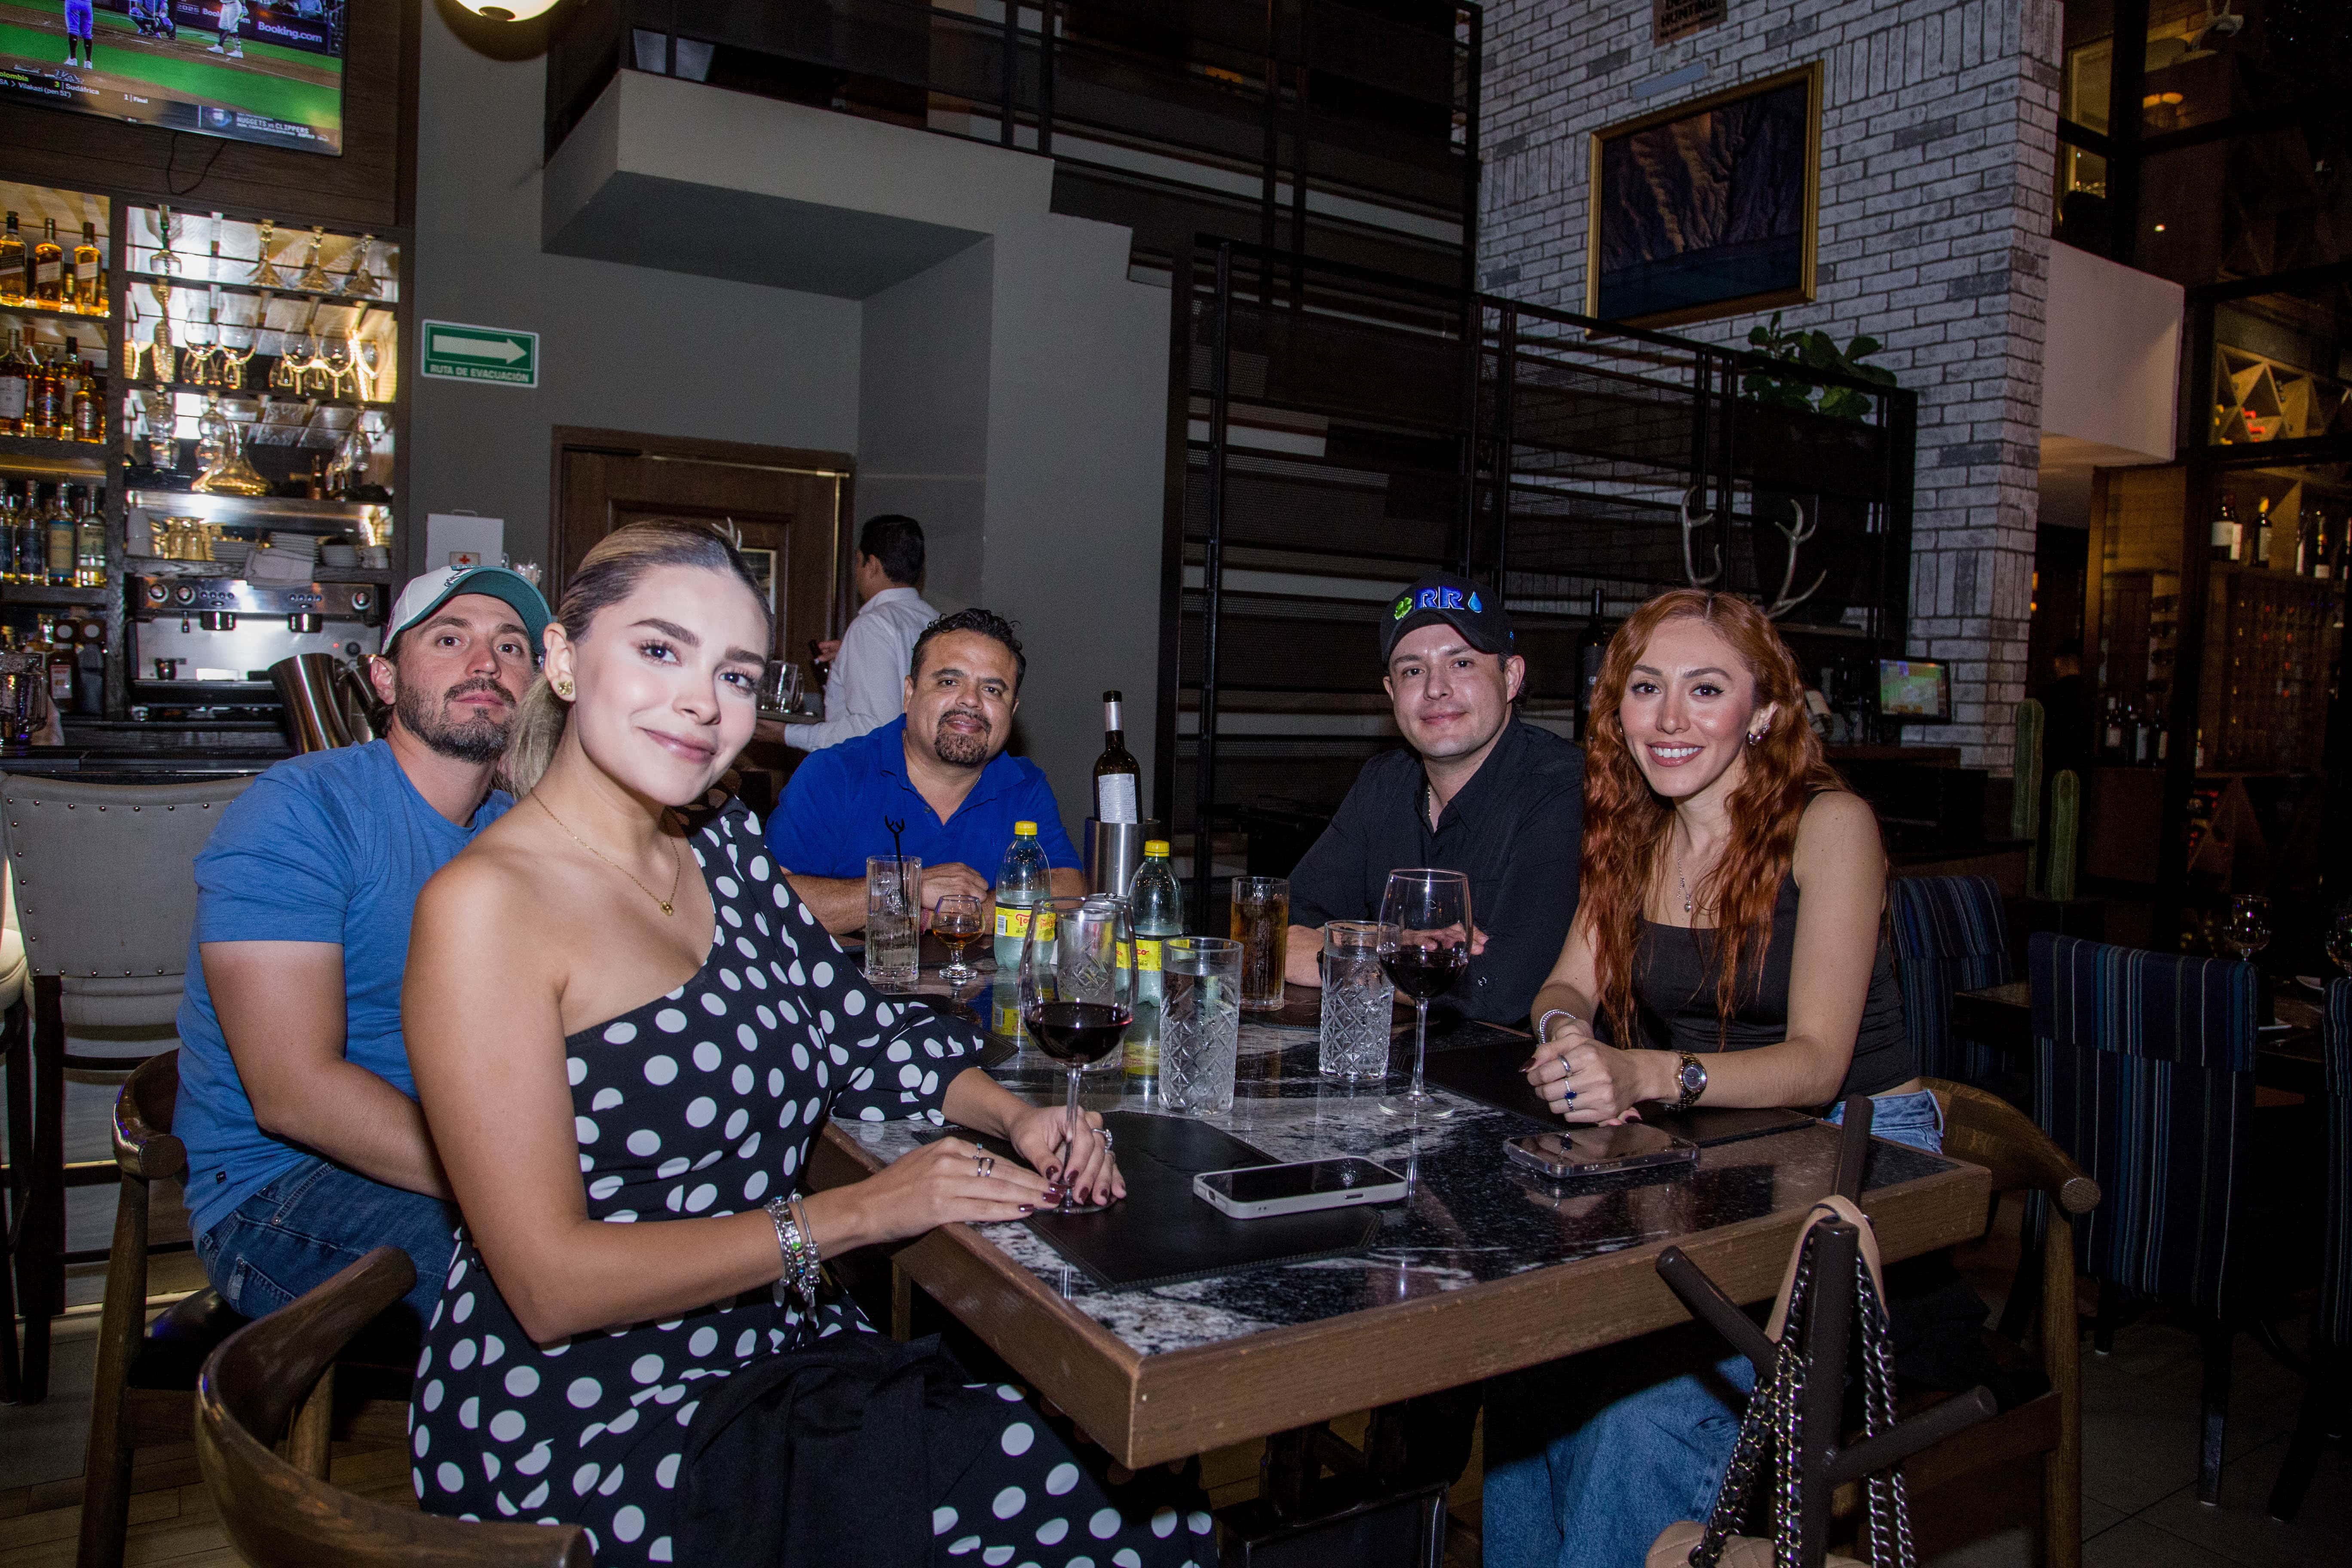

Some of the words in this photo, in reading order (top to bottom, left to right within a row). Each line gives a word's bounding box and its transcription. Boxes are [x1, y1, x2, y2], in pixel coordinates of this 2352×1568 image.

[177, 5, 199, 13] 2025
[258, 21, 322, 43] Booking.com
[0, 71, 29, 82] olombia
[65, 83, 100, 95] Sudáfrica
[18, 82, 43, 92] Vilakazi
[236, 116, 267, 126] NUGGETS
[275, 122, 310, 134] CLIPPERS
[430, 364, 454, 375] RUTA
[455, 367, 469, 377] DE
[1016, 913, 1031, 927] To
